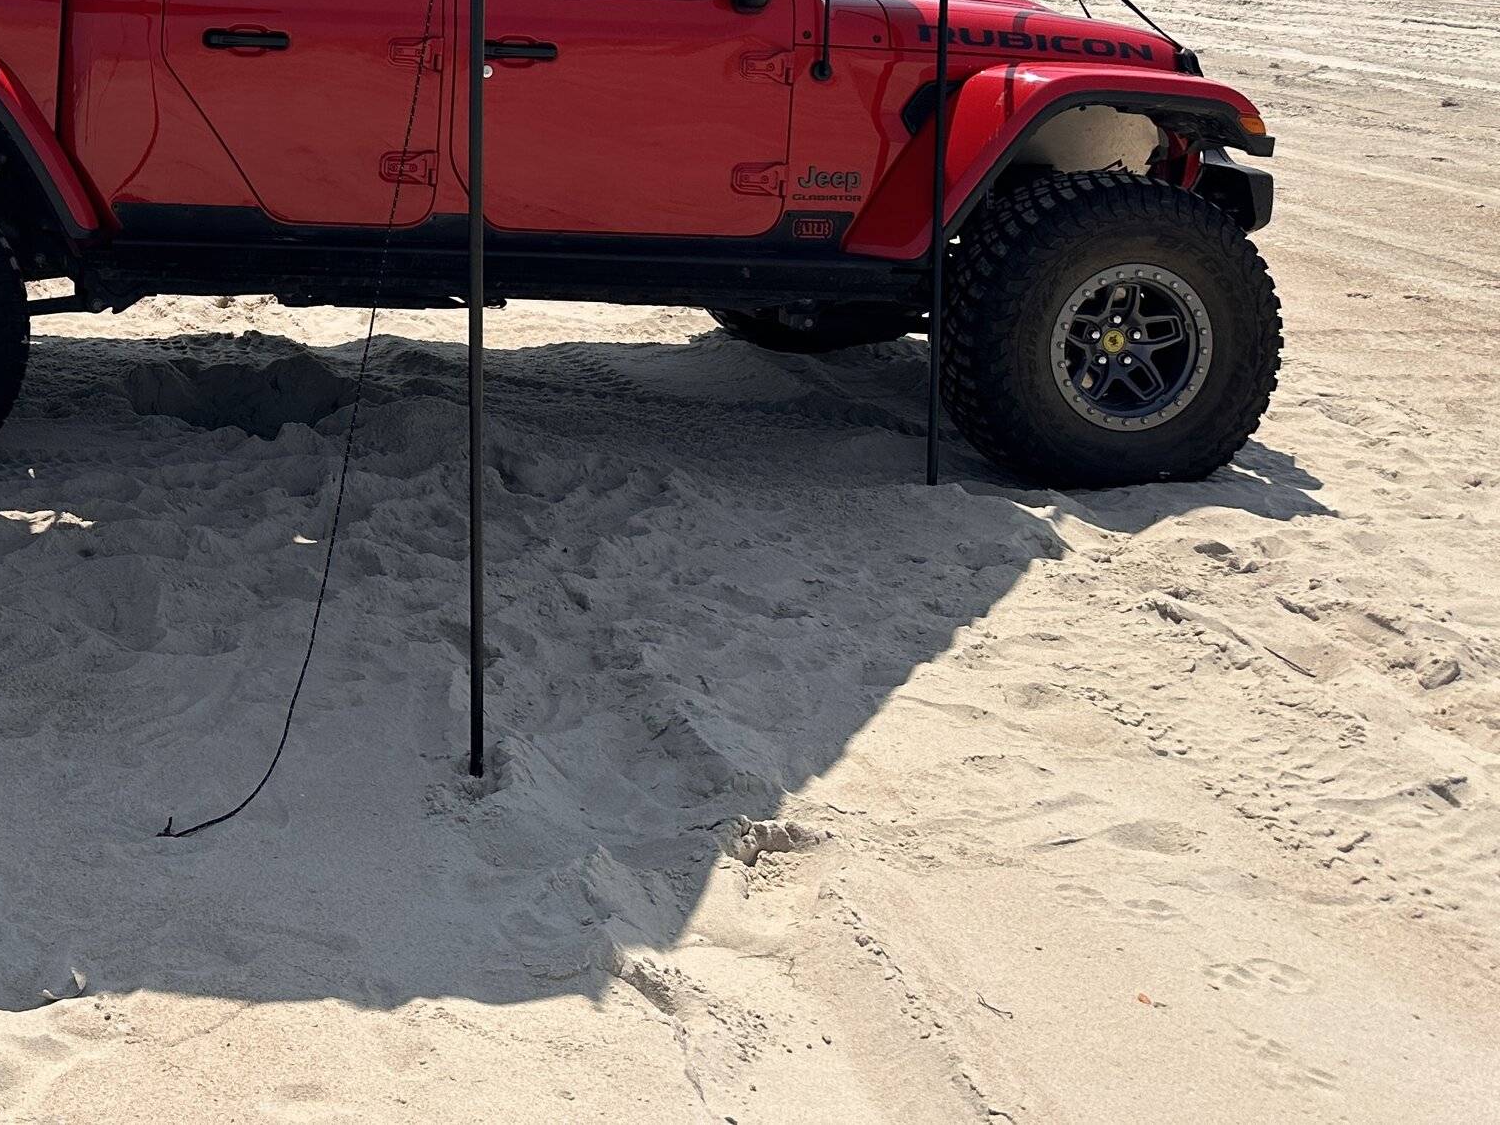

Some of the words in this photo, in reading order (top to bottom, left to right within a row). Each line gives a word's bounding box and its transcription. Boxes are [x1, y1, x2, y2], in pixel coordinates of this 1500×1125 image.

[916, 23, 1154, 61] RUBICON
[797, 165, 861, 192] Jeep
[792, 193, 862, 203] GLADIATOR
